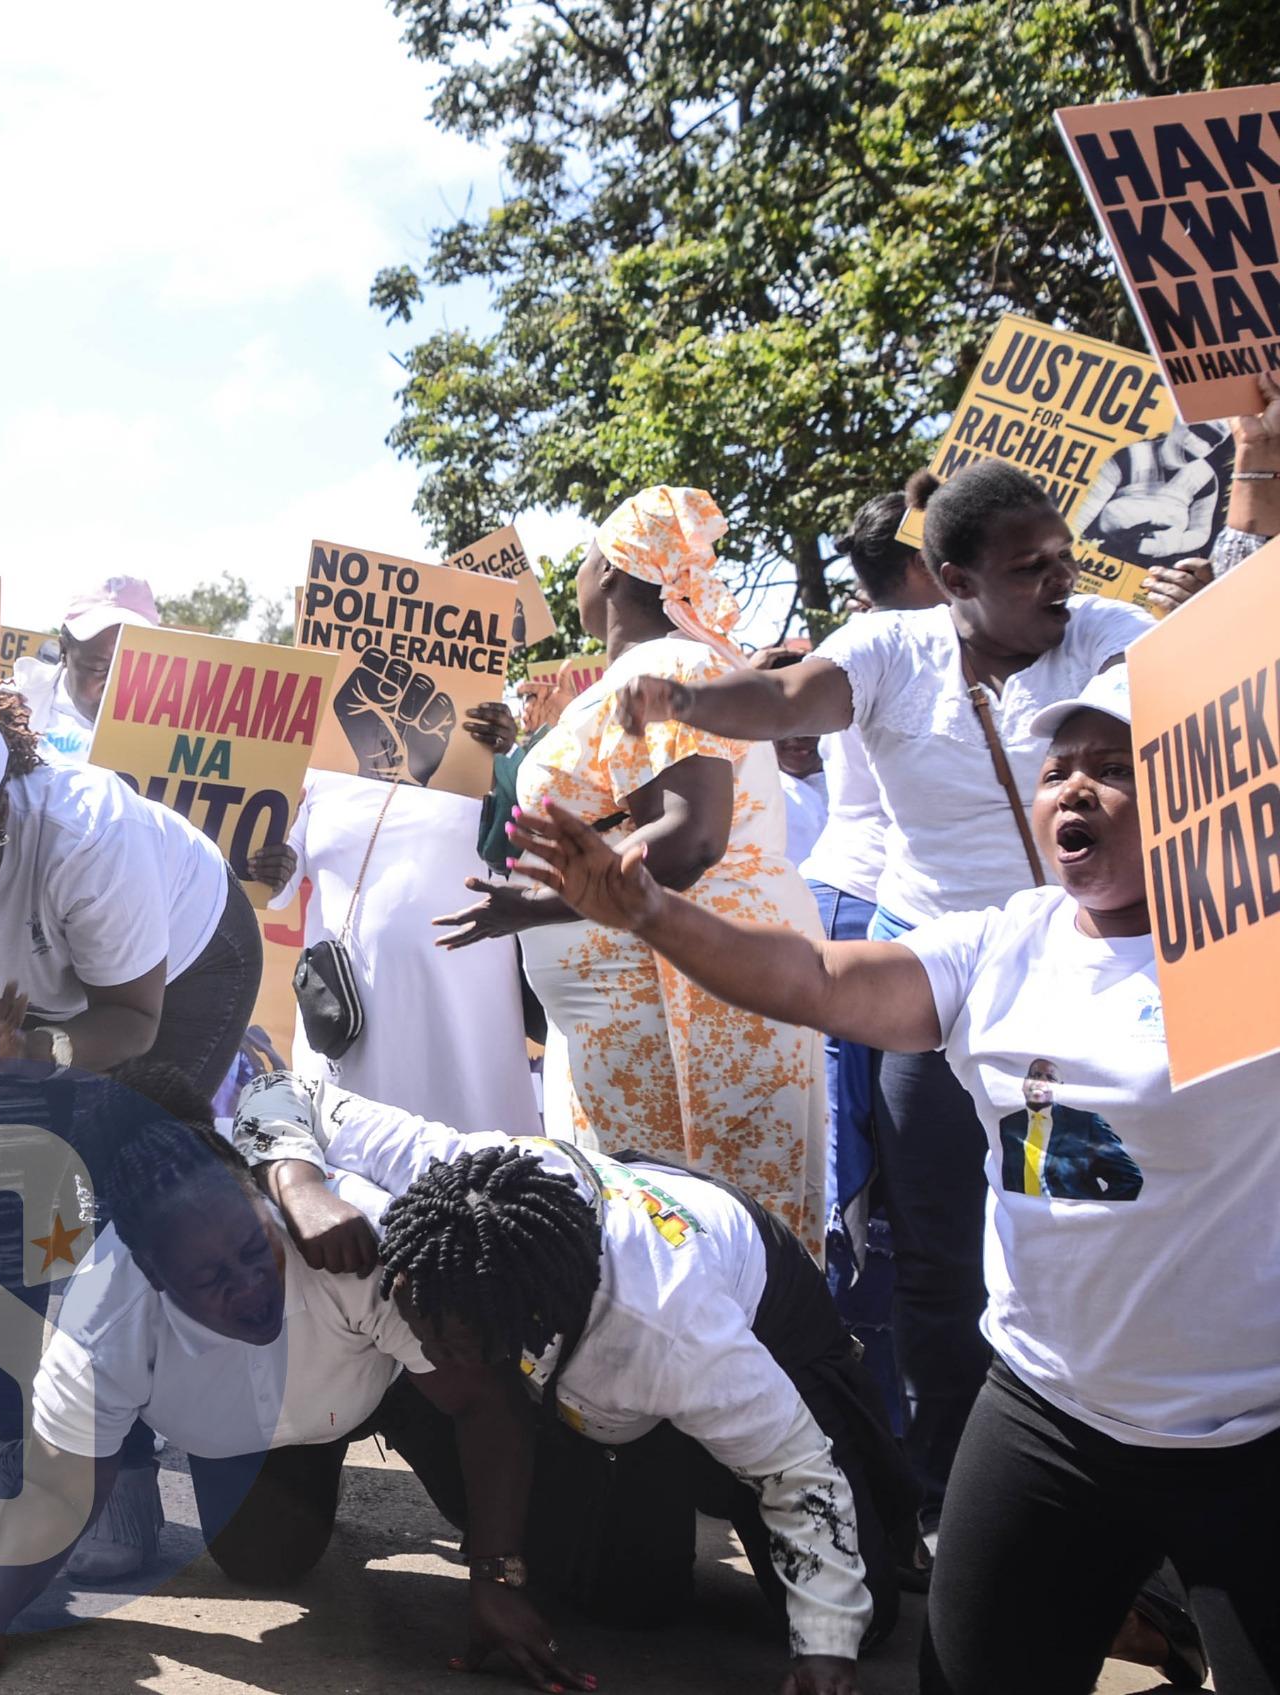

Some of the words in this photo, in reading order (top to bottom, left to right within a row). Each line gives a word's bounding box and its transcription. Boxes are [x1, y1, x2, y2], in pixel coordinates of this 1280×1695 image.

[1075, 110, 1280, 205] HAK
[980, 331, 1168, 435] JUSTICE
[1165, 355, 1197, 385] NI
[1197, 345, 1262, 382] HAKI
[954, 405, 1099, 486] RACHAEL
[1031, 406, 1064, 429] FOR
[310, 546, 370, 586] NO
[378, 563, 420, 596] TO
[453, 552, 475, 571] TO
[306, 582, 508, 648] POLITICAL
[112, 649, 323, 746] WAMAMA
[168, 734, 232, 780] NA
